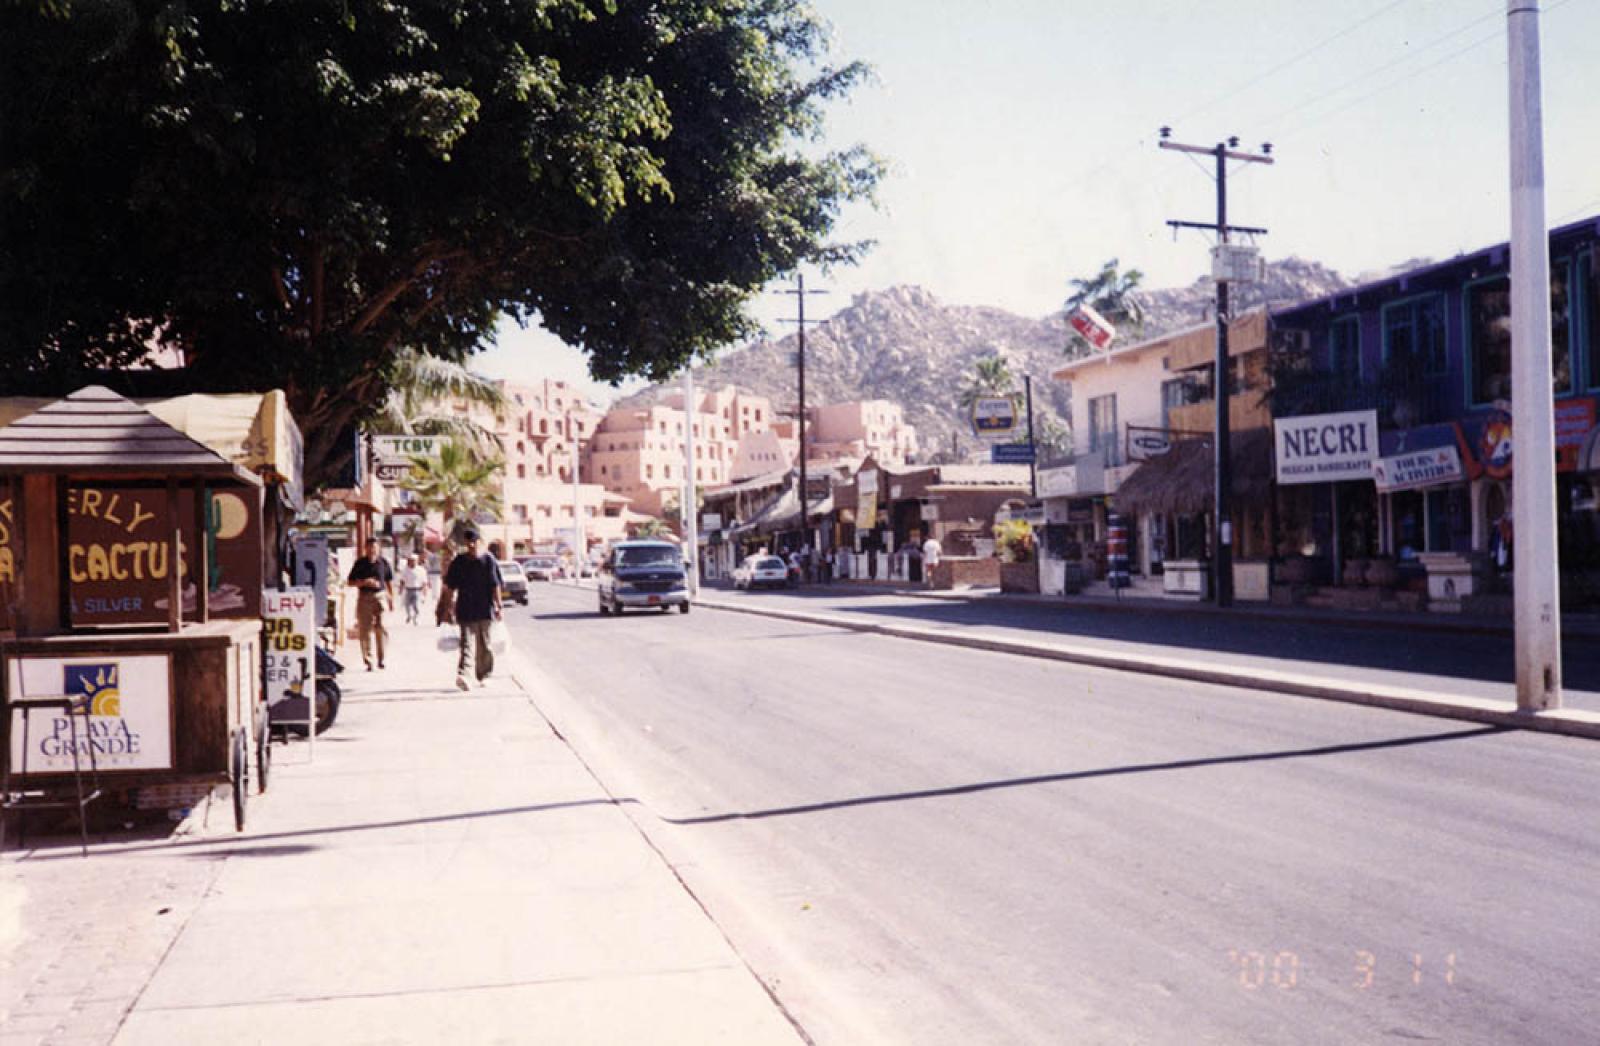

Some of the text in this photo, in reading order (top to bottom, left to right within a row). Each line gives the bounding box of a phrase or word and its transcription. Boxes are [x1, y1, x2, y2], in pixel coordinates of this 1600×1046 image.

[1284, 423, 1367, 458] NECRI
[85, 597, 143, 613] SILVER
[39, 735, 140, 756] GRANDE
